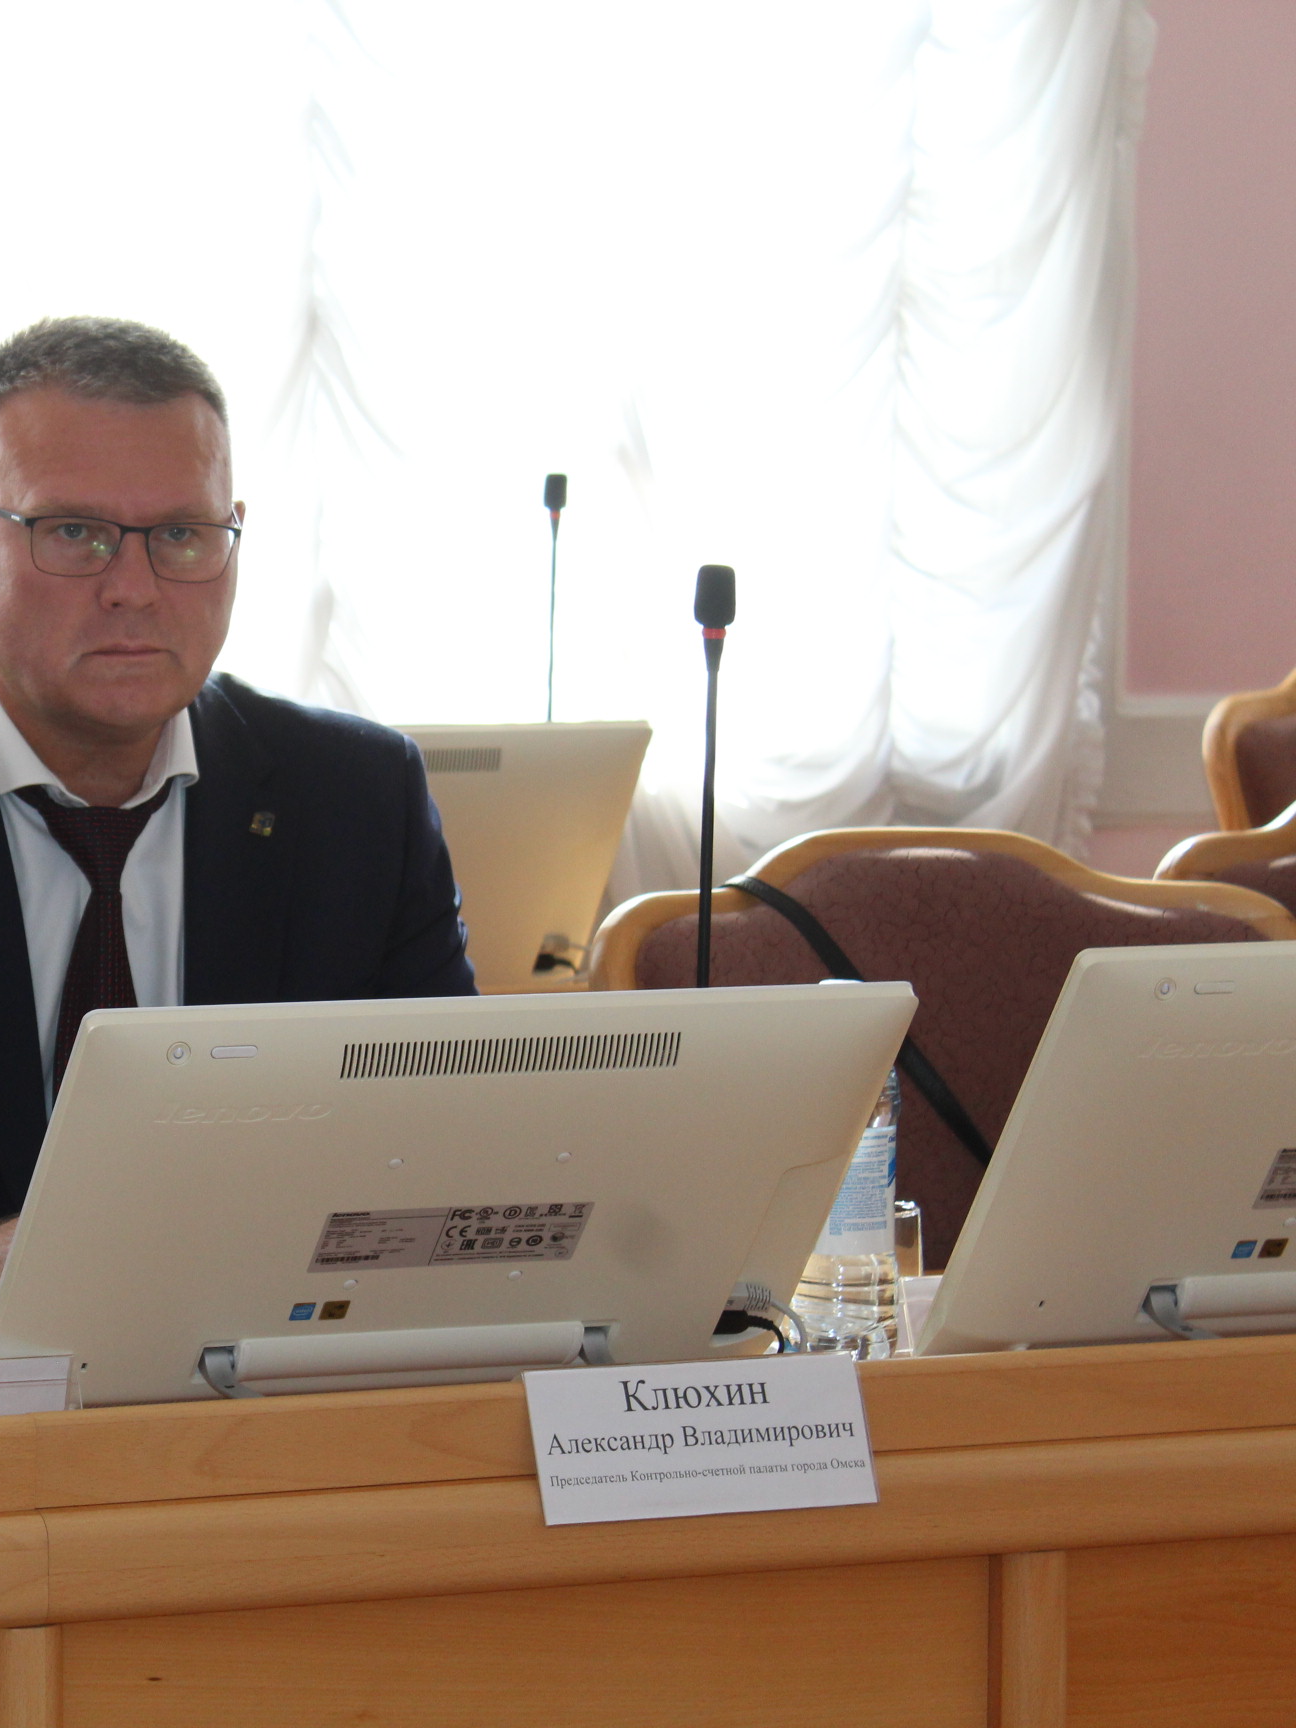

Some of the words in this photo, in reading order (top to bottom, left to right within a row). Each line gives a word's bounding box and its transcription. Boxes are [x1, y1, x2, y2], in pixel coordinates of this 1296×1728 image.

[153, 1103, 334, 1124] lenovo
[619, 1379, 770, 1413] Клюхин
[547, 1432, 675, 1455] Александр
[681, 1421, 856, 1452] Владимирович
[550, 1471, 628, 1488] Председатель
[630, 1463, 746, 1483] Контрольно-счетной
[749, 1461, 788, 1475] палаты
[791, 1459, 828, 1473] города
[830, 1457, 866, 1470] Омска
